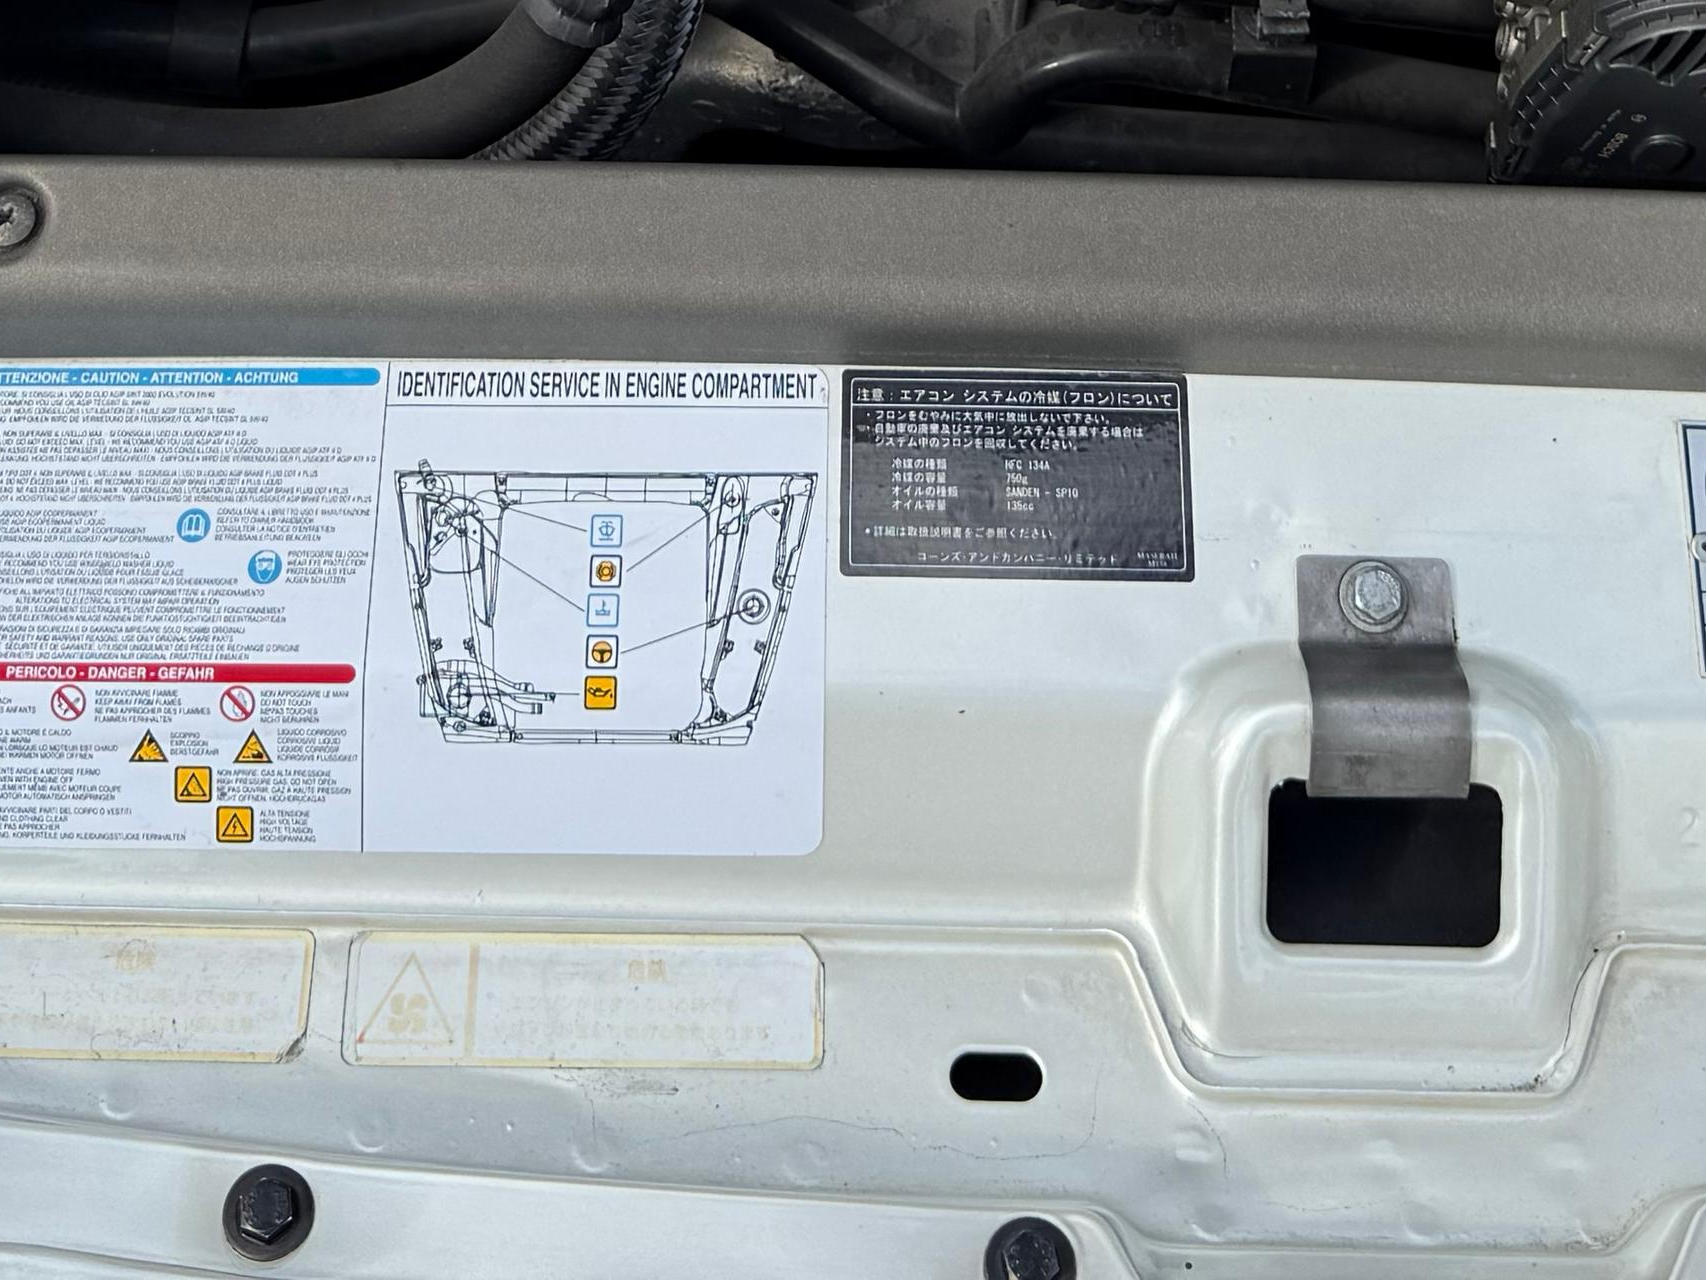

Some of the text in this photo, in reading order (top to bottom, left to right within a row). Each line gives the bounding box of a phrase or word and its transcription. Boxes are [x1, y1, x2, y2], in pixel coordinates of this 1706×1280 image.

[80, 371, 140, 383] CAUTION
[150, 371, 224, 383] ATTENTION
[235, 372, 298, 384] ACHTUNG
[397, 370, 817, 400] IDENTIFICATION SERVICE IN ENGINE COMPARTMENT
[1004, 459, 1050, 471] HFC 134A
[1005, 473, 1028, 485] 750g
[1005, 487, 1040, 498] SANDEN
[1006, 501, 1035, 512] 135cc
[6, 666, 77, 678] PERICOLO
[87, 666, 147, 678] DANGER
[158, 667, 214, 679] GEFAHR
